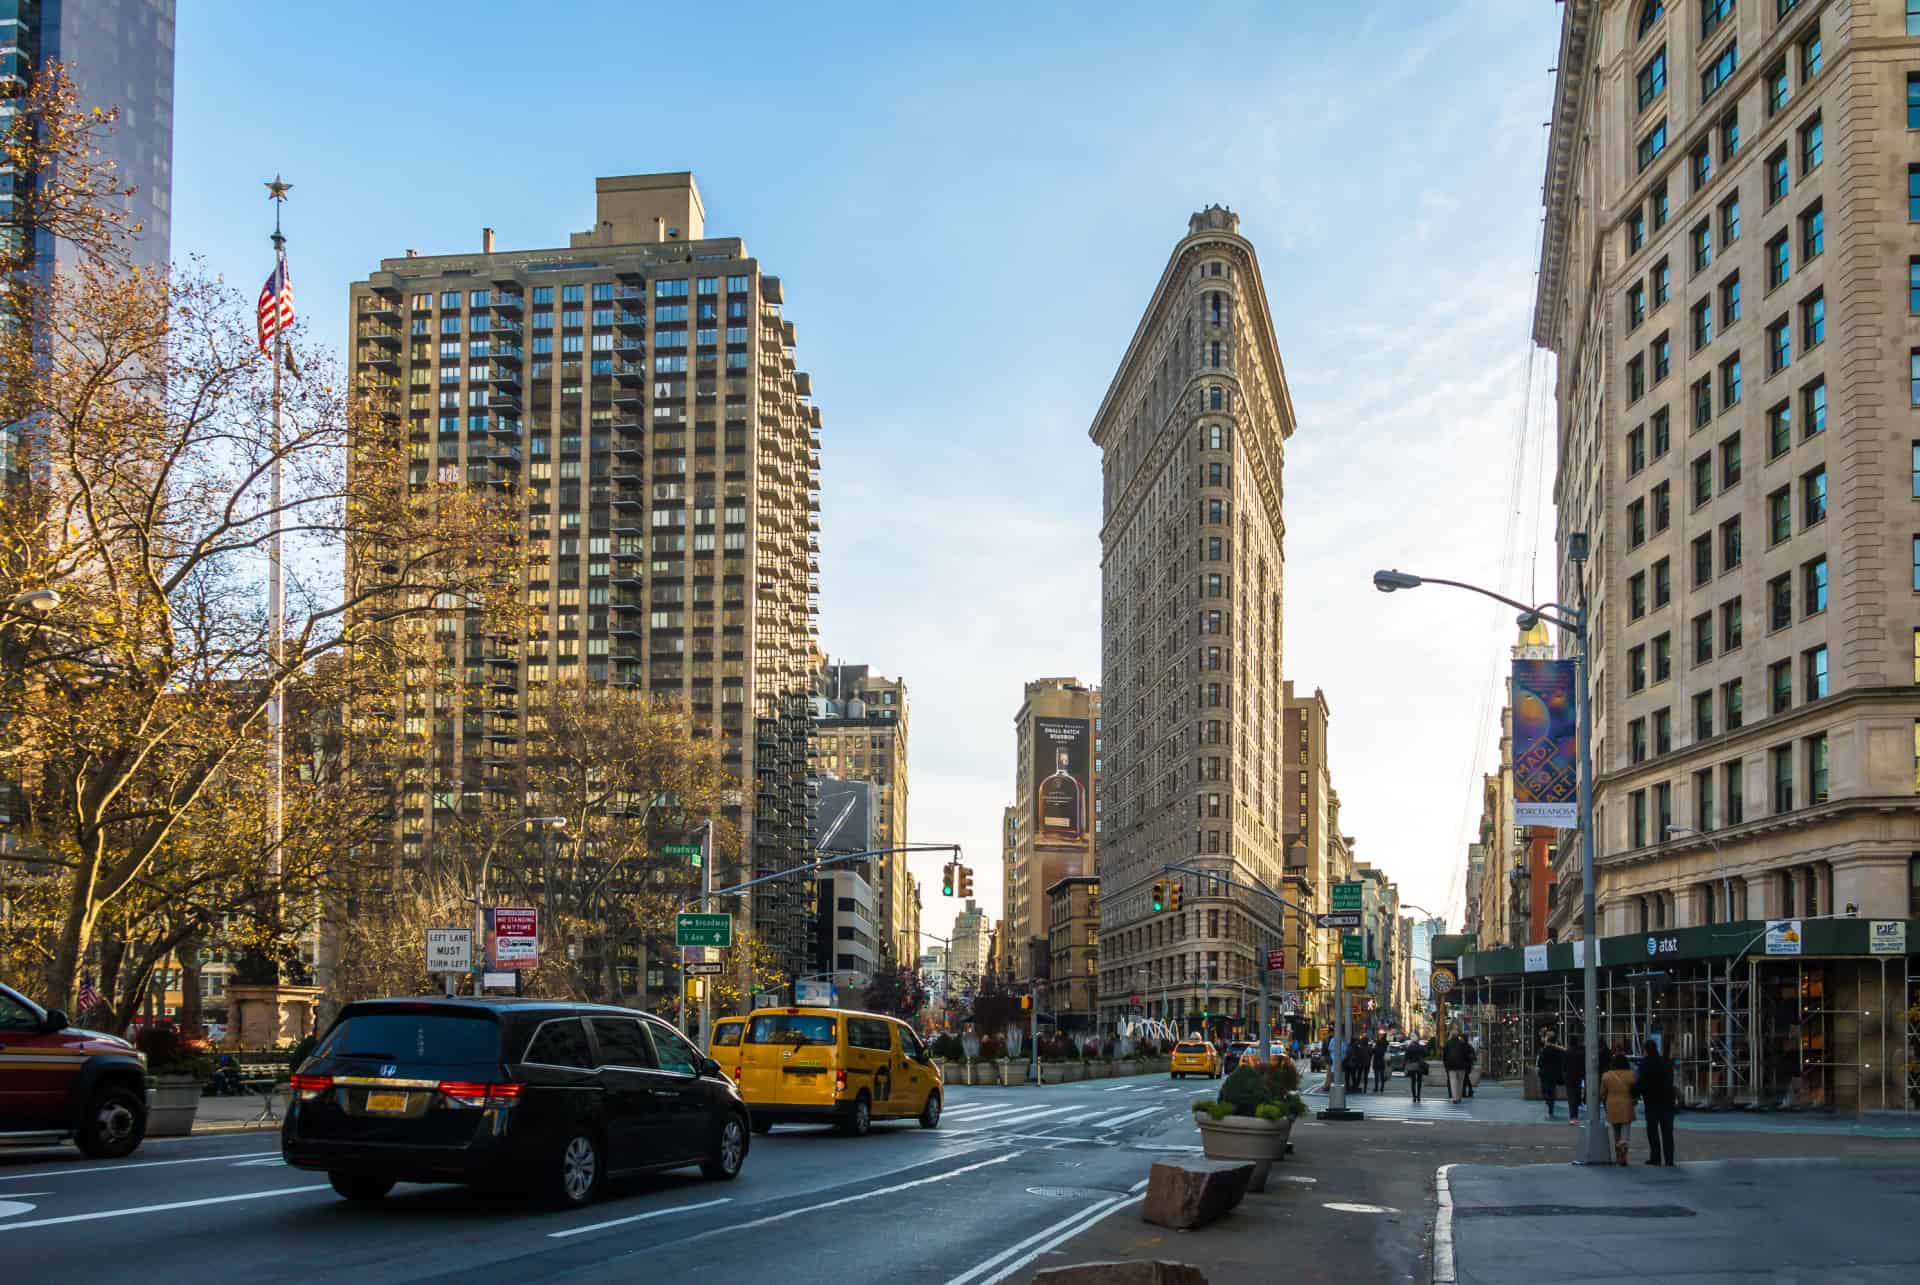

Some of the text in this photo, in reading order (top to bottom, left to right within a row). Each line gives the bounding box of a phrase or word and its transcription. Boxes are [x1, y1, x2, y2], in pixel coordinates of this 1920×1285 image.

[695, 919, 729, 929] Broadway
[430, 934, 469, 942] LEFT LANE
[437, 946, 460, 955] MUST
[430, 960, 468, 968] TURN LEFT
